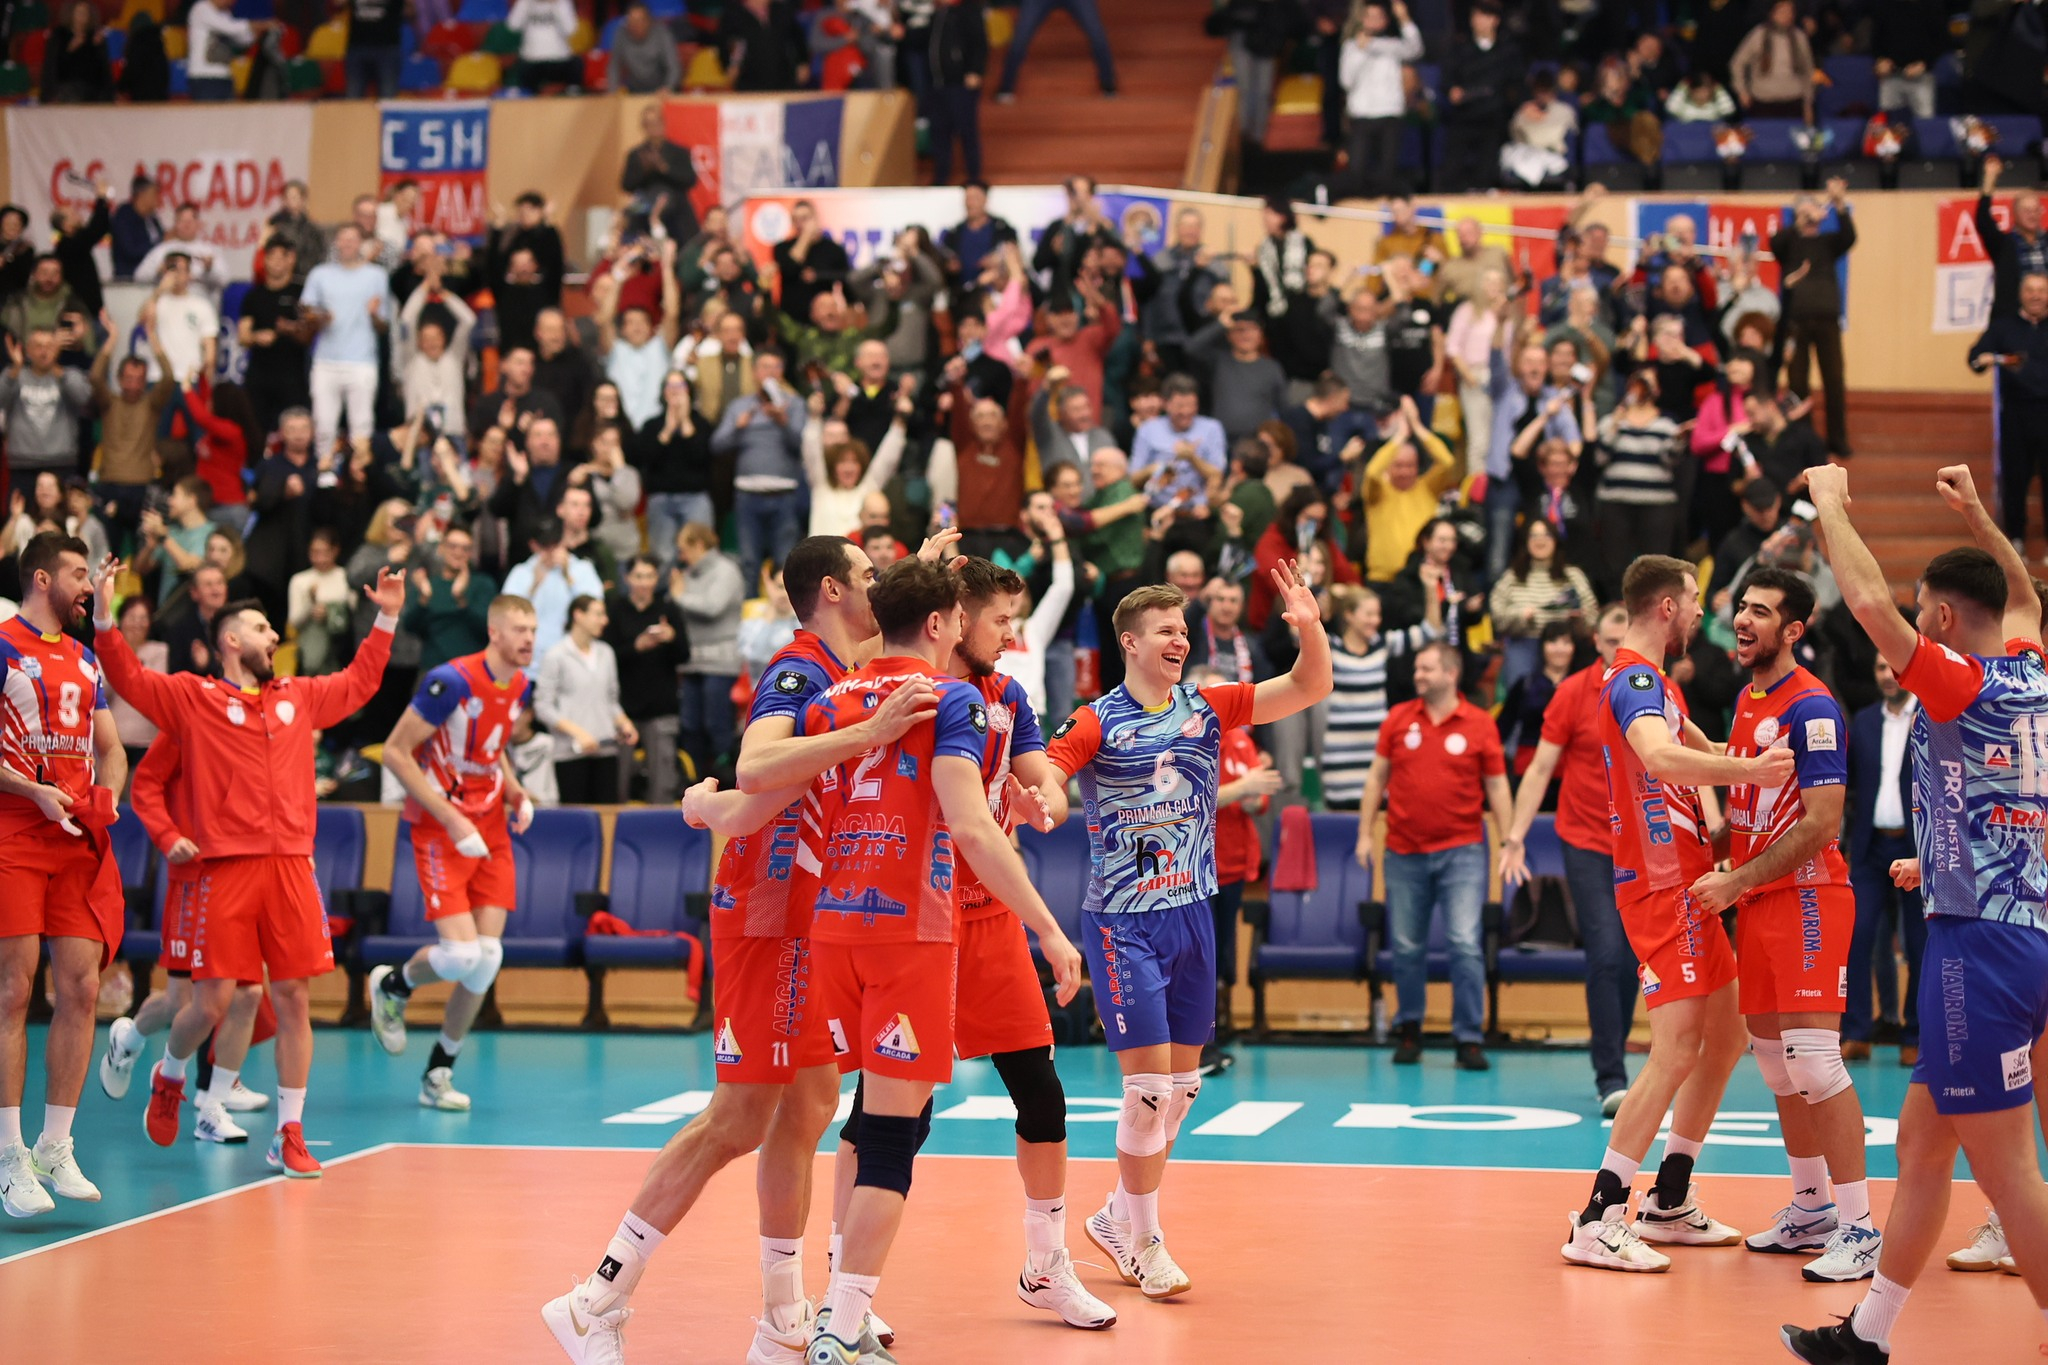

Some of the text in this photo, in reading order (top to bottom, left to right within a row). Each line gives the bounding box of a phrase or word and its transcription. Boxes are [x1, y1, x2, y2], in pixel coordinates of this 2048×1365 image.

[482, 722, 504, 760] 4
[1811, 737, 1833, 745] Arcada
[1154, 749, 1179, 794] 6
[1824, 777, 1841, 785] ARCADA
[1939, 760, 1964, 872] PRO INSTAL
[1934, 807, 1947, 873] CALARASI
[1799, 887, 1823, 952] NAVROM
[170, 940, 187, 958] 10
[1681, 962, 1697, 984] 5
[1941, 957, 1969, 1041] NAVROM
[1116, 1012, 1127, 1034] 6
[771, 1041, 790, 1067] 11
[880, 1049, 912, 1061] ARCADA
[1950, 1087, 1976, 1097] Atletik
[2008, 1076, 2030, 1088] EVENTS
